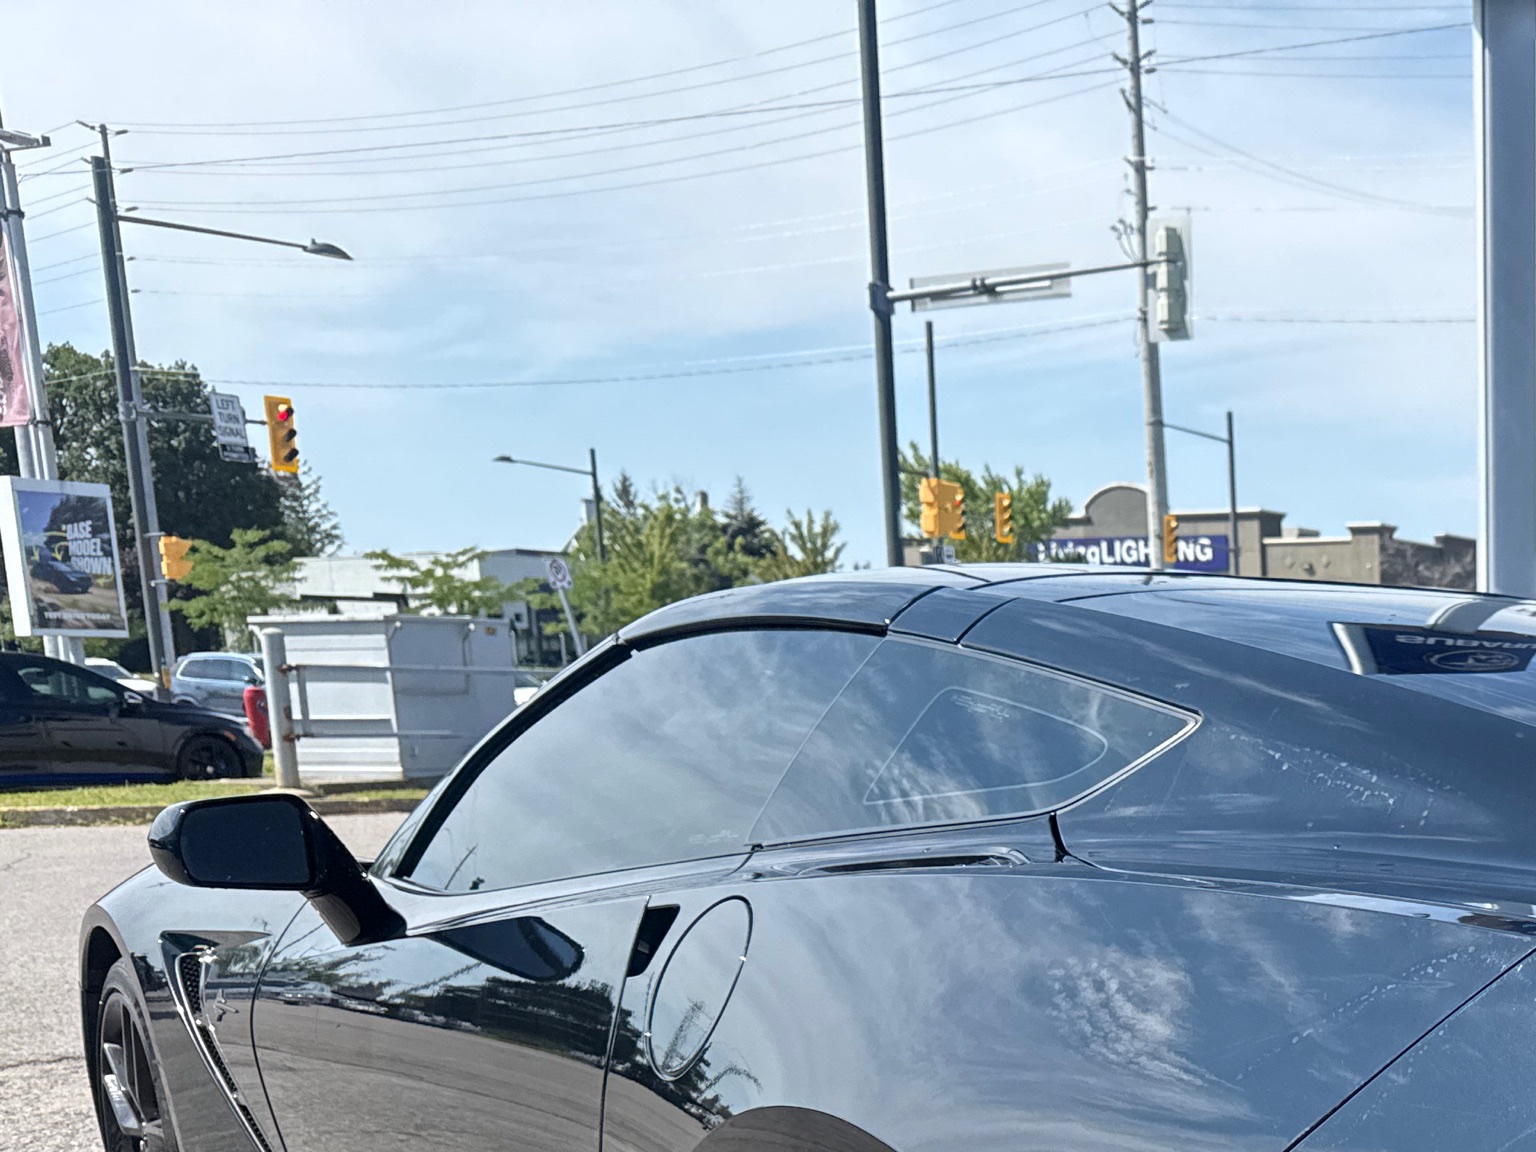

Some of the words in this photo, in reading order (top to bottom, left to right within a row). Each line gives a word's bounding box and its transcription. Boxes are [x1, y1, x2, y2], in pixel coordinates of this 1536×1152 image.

[215, 398, 236, 410] LEFT
[218, 411, 240, 425] TURN
[67, 538, 104, 556] MODEL
[71, 556, 112, 576] SHOWN
